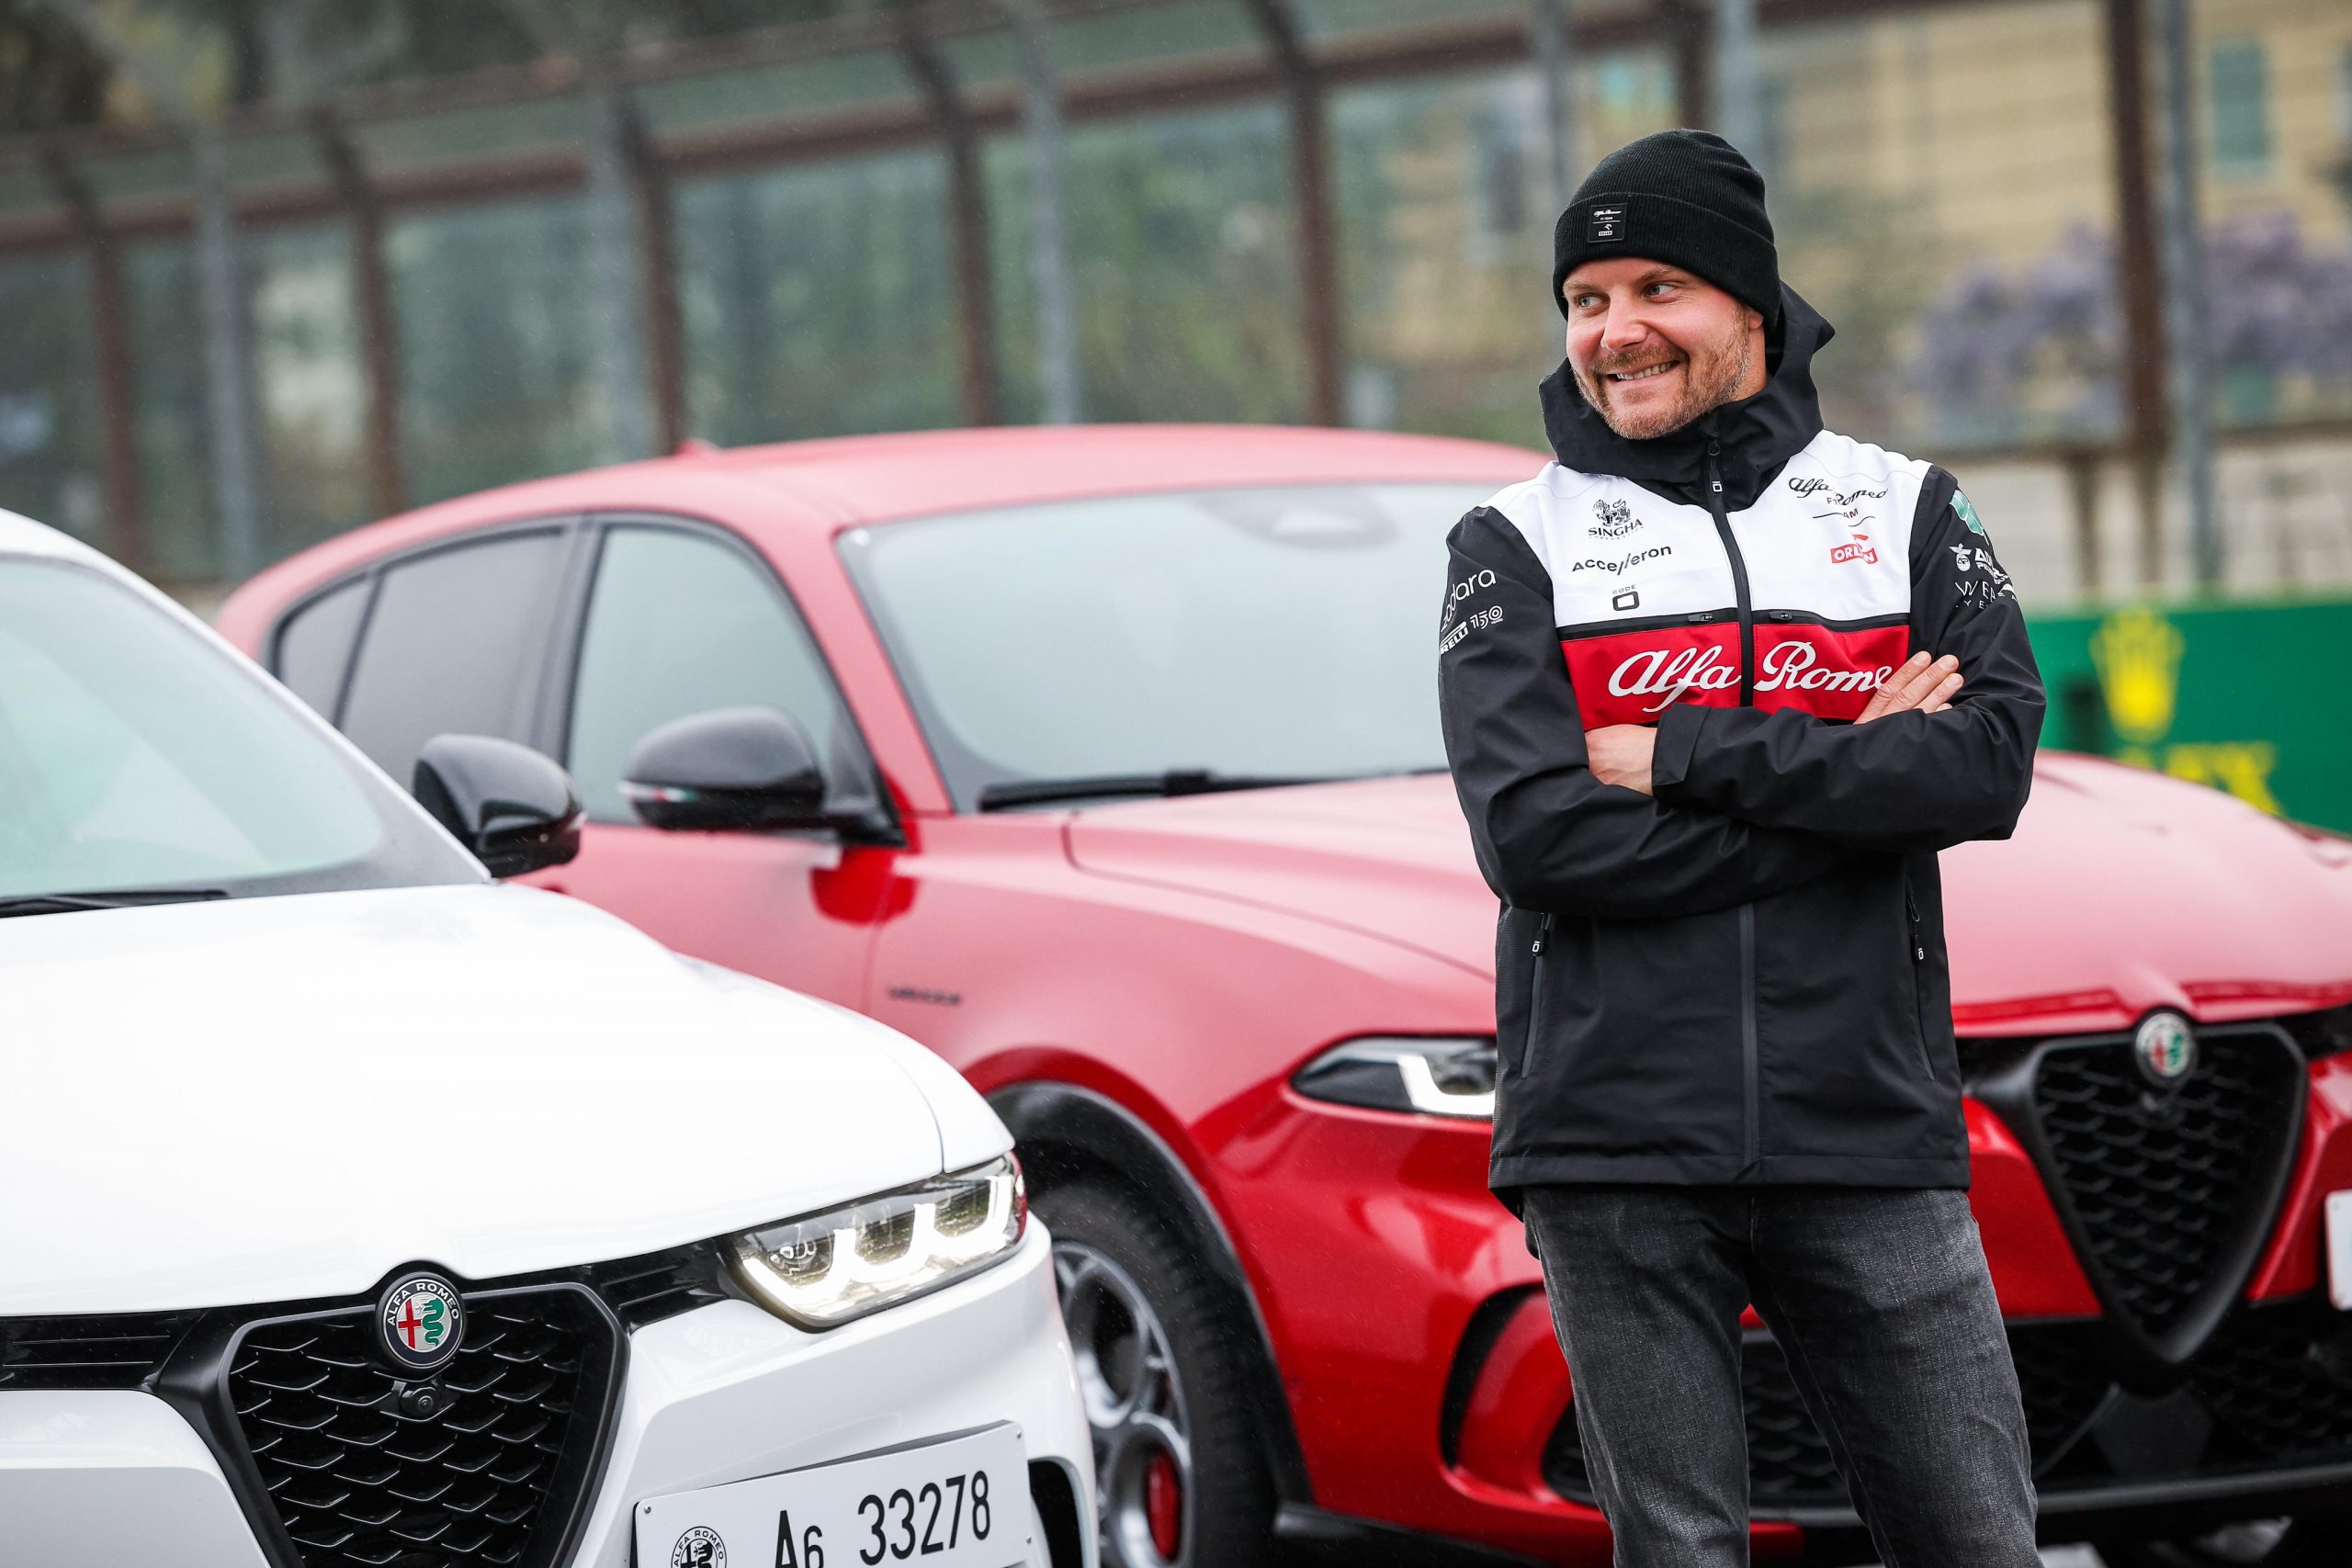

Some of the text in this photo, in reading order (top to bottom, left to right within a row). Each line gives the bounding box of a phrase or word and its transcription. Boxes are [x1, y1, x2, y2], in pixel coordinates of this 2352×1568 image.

[1788, 478, 1834, 498] Alfa
[1588, 518, 1644, 537] SINGHA
[1833, 547, 1875, 563] ORLN
[1612, 584, 1636, 594] CODE
[1608, 641, 1894, 713] Alfa Rome
[387, 1282, 459, 1326] ALFA ROMEO
[857, 1470, 991, 1566] 33278
[673, 1529, 724, 1568] ALFA ROMEO
